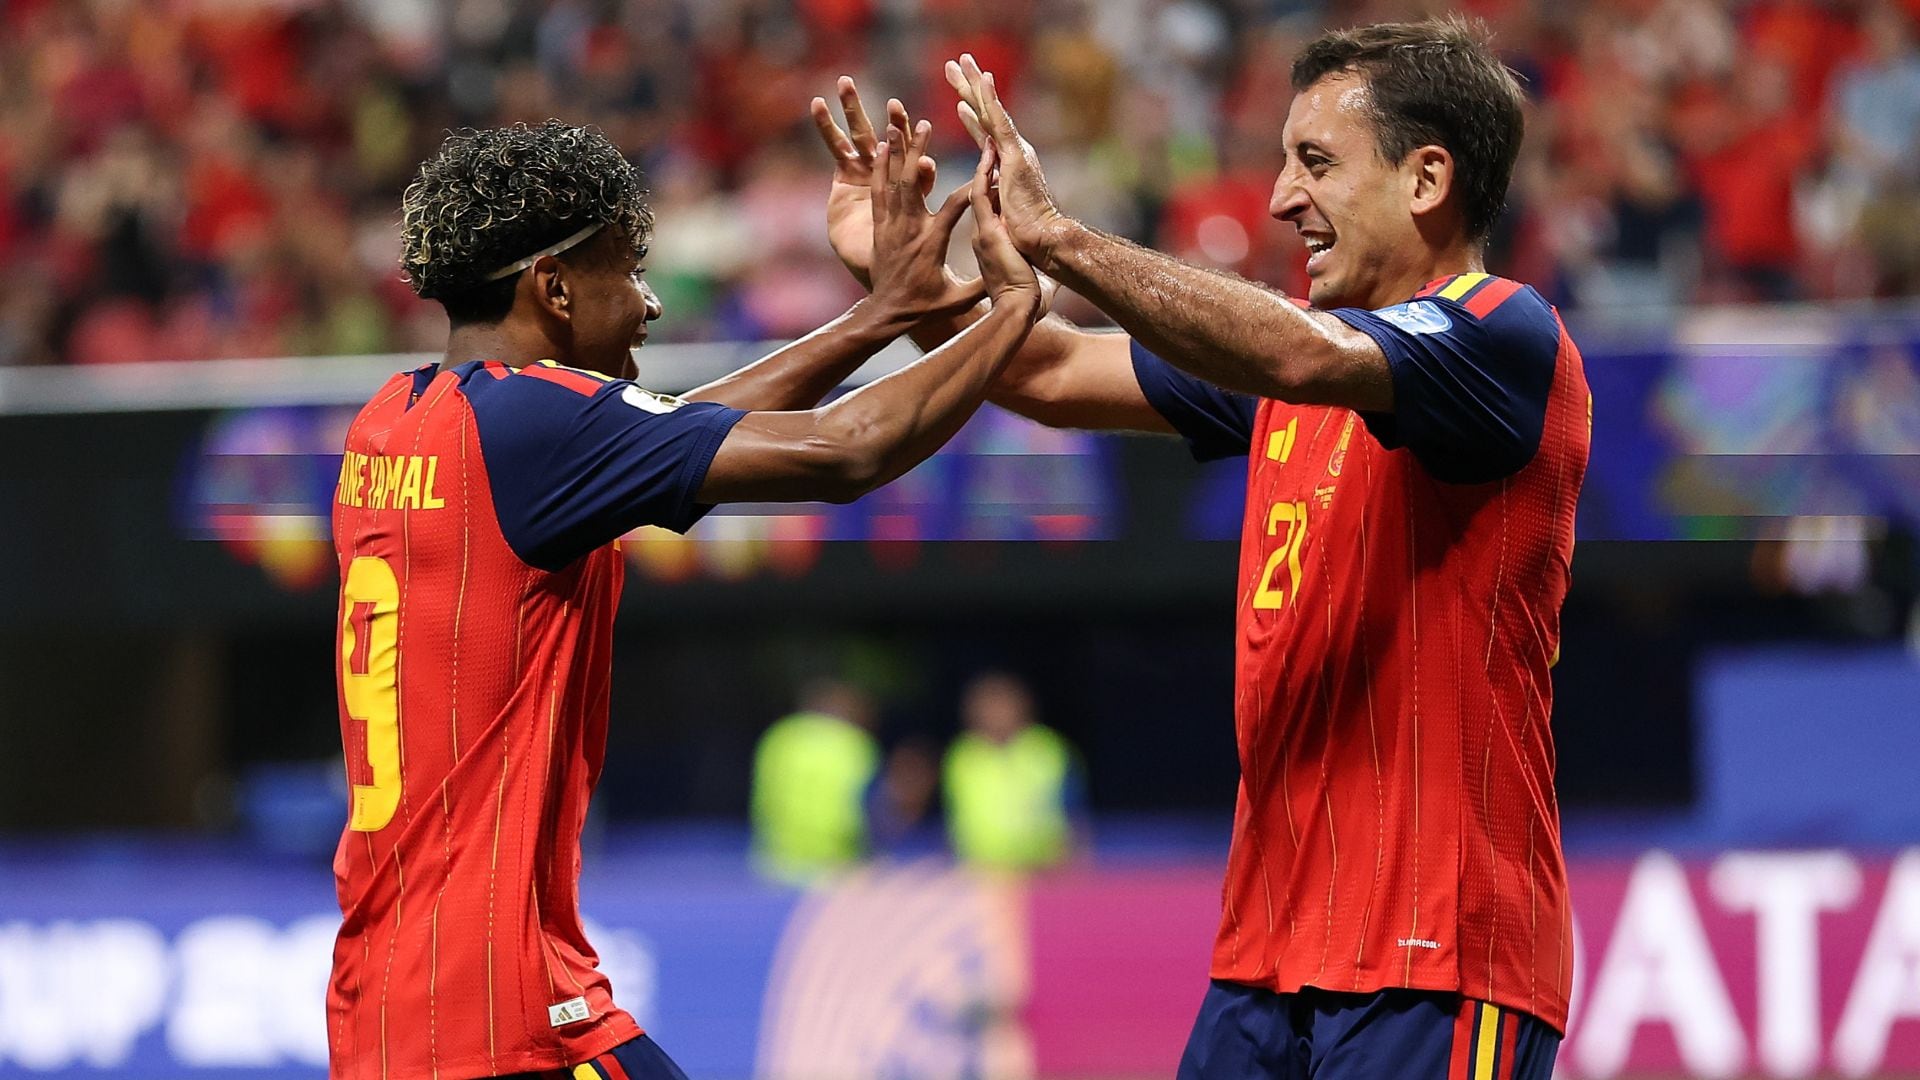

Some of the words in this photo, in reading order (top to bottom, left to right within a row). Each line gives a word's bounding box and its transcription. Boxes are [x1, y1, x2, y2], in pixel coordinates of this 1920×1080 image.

[368, 455, 445, 510] YAMAL
[1253, 501, 1307, 609] 21
[342, 556, 402, 832] 9
[1555, 850, 1920, 1080] ATA
